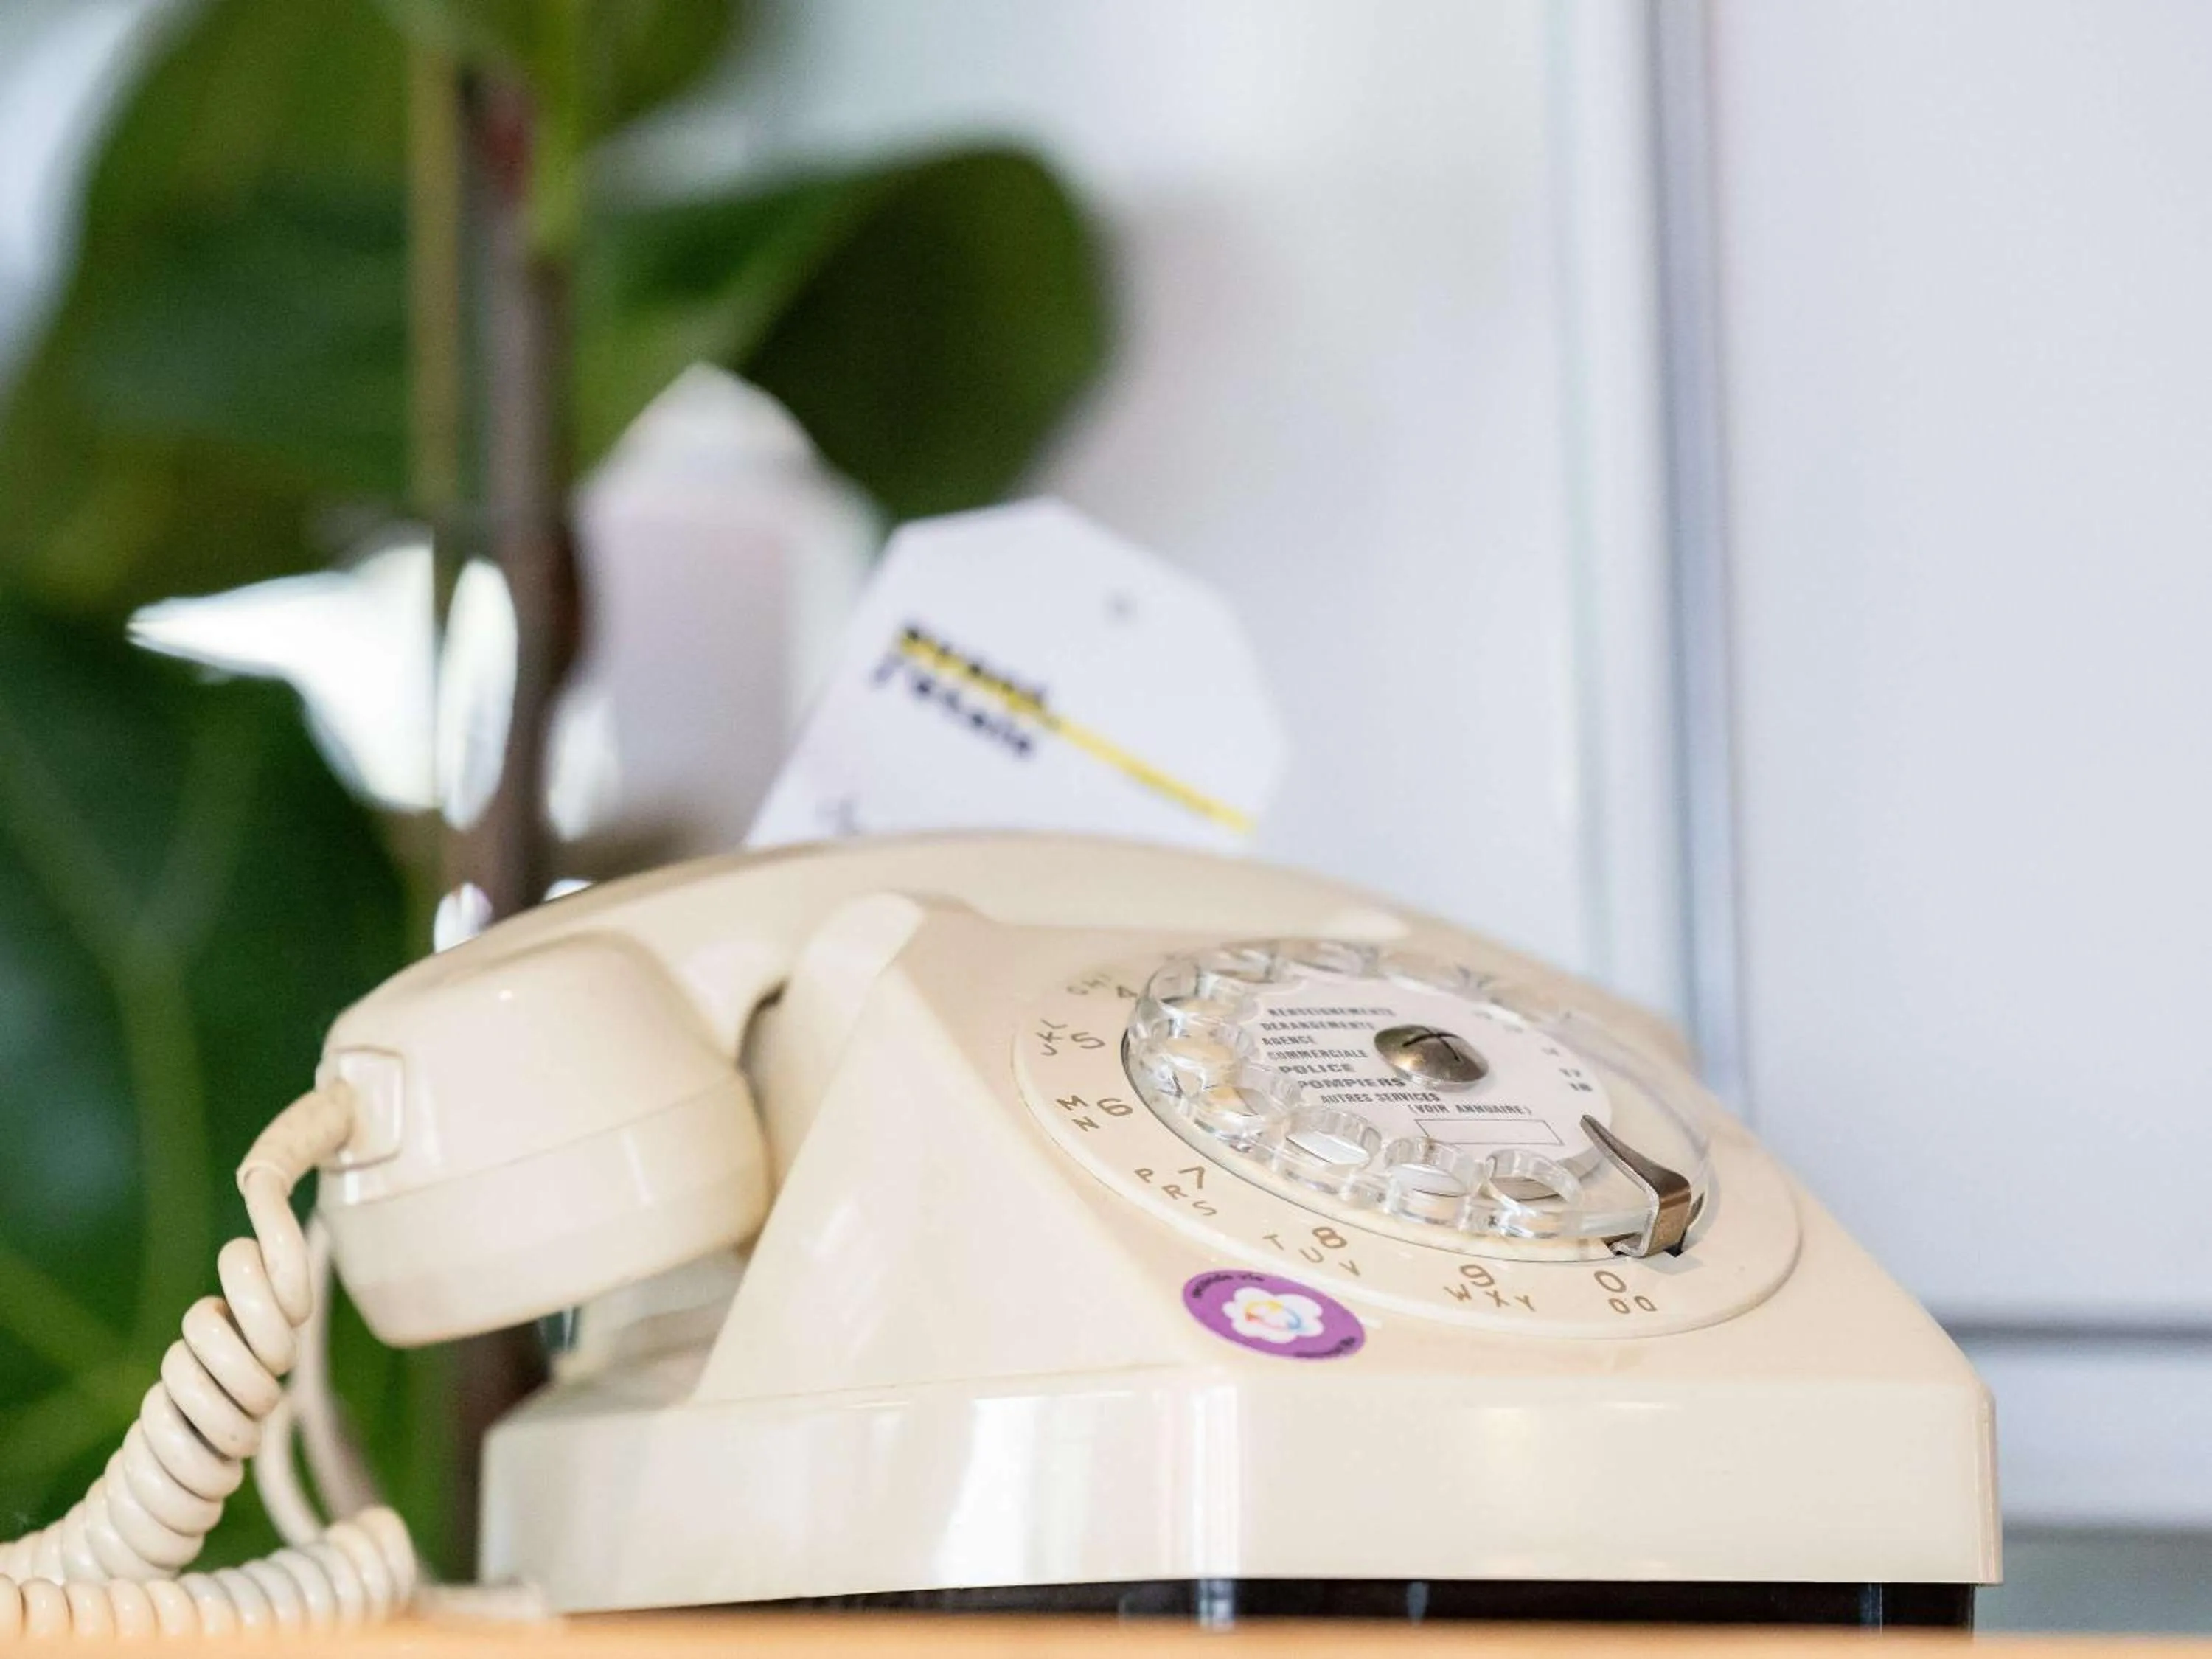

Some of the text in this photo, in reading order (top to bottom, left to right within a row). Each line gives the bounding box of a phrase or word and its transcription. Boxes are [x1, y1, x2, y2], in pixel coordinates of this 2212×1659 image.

[1071, 1032, 1106, 1050] 5
[1262, 1035, 1317, 1046] AGENCE
[1267, 1049, 1369, 1060] COMMERCIALE
[1278, 1064, 1356, 1074] POLICE
[1297, 1077, 1407, 1090] POMPIERS
[1321, 1092, 1441, 1105] AUTRES SERVICES
[1096, 1098, 1133, 1116] 6
[1407, 1105, 1533, 1116] (VOIR ANNUAIRE)
[1178, 1166, 1206, 1189] 7
[1312, 1226, 1348, 1248] 8
[1459, 1264, 1495, 1287] 9
[1593, 1270, 1627, 1293] 0
